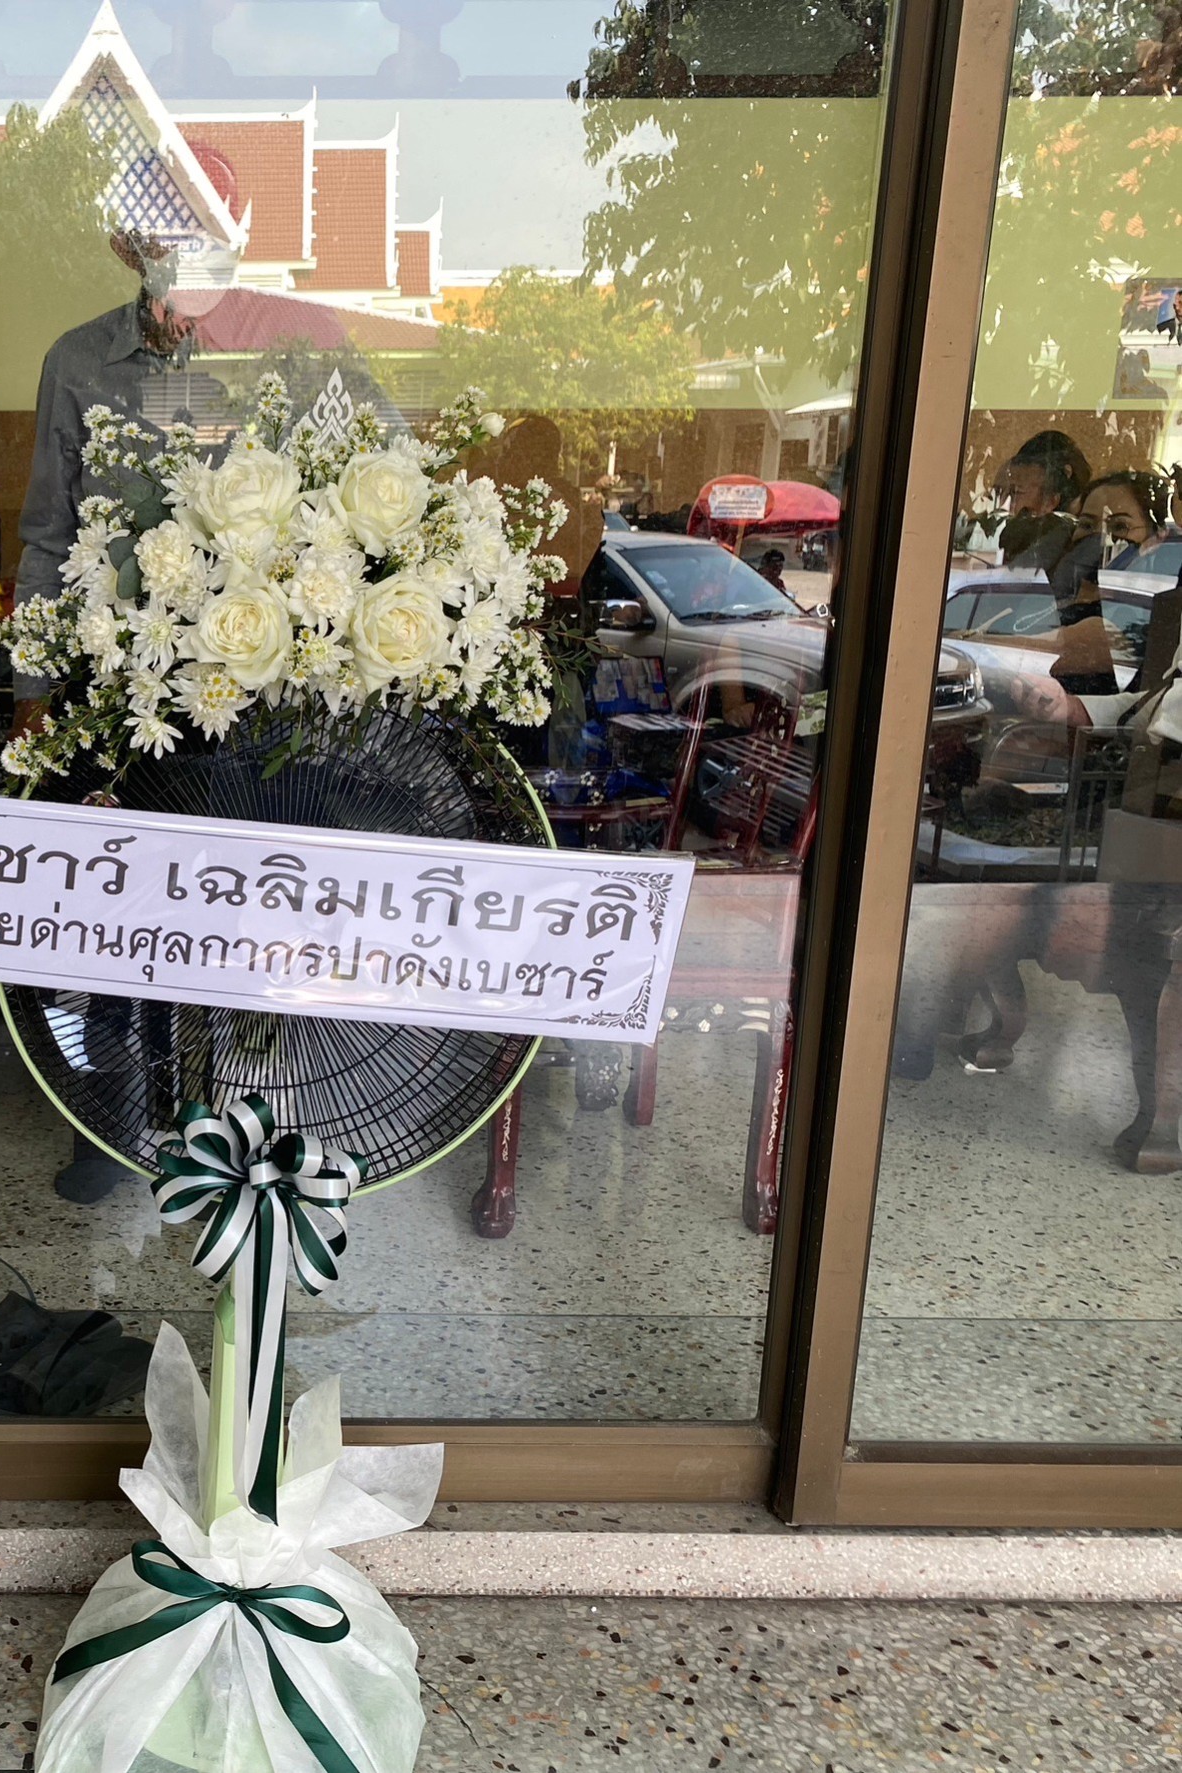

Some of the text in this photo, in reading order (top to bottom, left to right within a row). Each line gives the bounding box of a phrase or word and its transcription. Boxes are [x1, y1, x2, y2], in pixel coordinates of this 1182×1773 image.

[167, 853, 637, 941] เฉลิมเกียรติ
